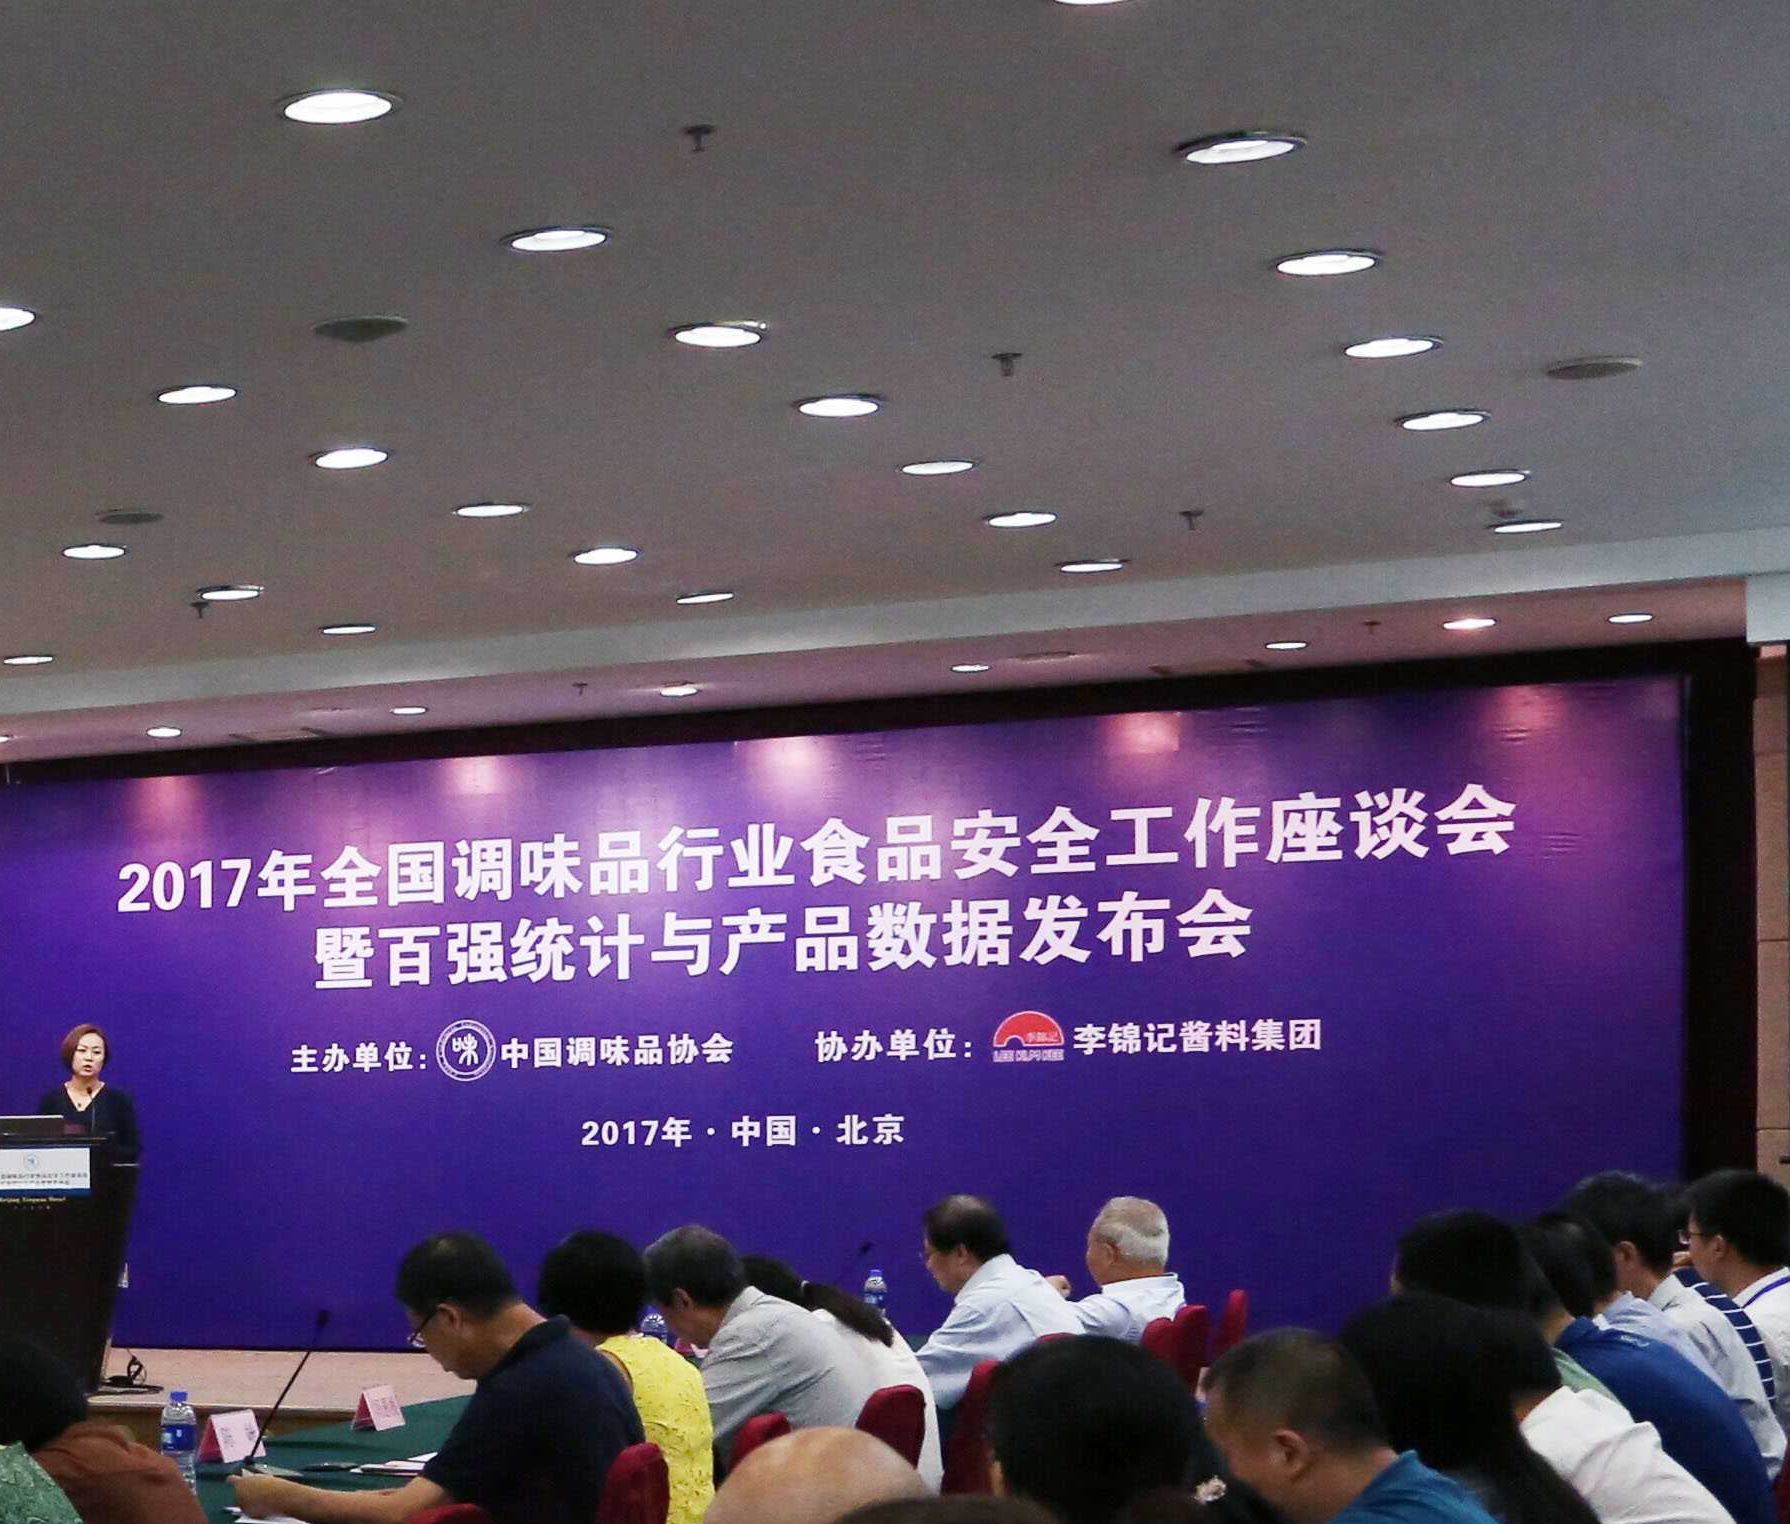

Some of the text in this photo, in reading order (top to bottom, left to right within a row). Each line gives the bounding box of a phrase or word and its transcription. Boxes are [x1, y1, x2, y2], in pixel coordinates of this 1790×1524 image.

[117, 783, 1517, 912] 2017年全国调味品行业食品安全工作座谈会
[314, 888, 1253, 989] 暨百强统计与产品数据发布会
[500, 1031, 734, 1069] 中国调味品协会
[1073, 1018, 1322, 1056] 李锦记酱料集团
